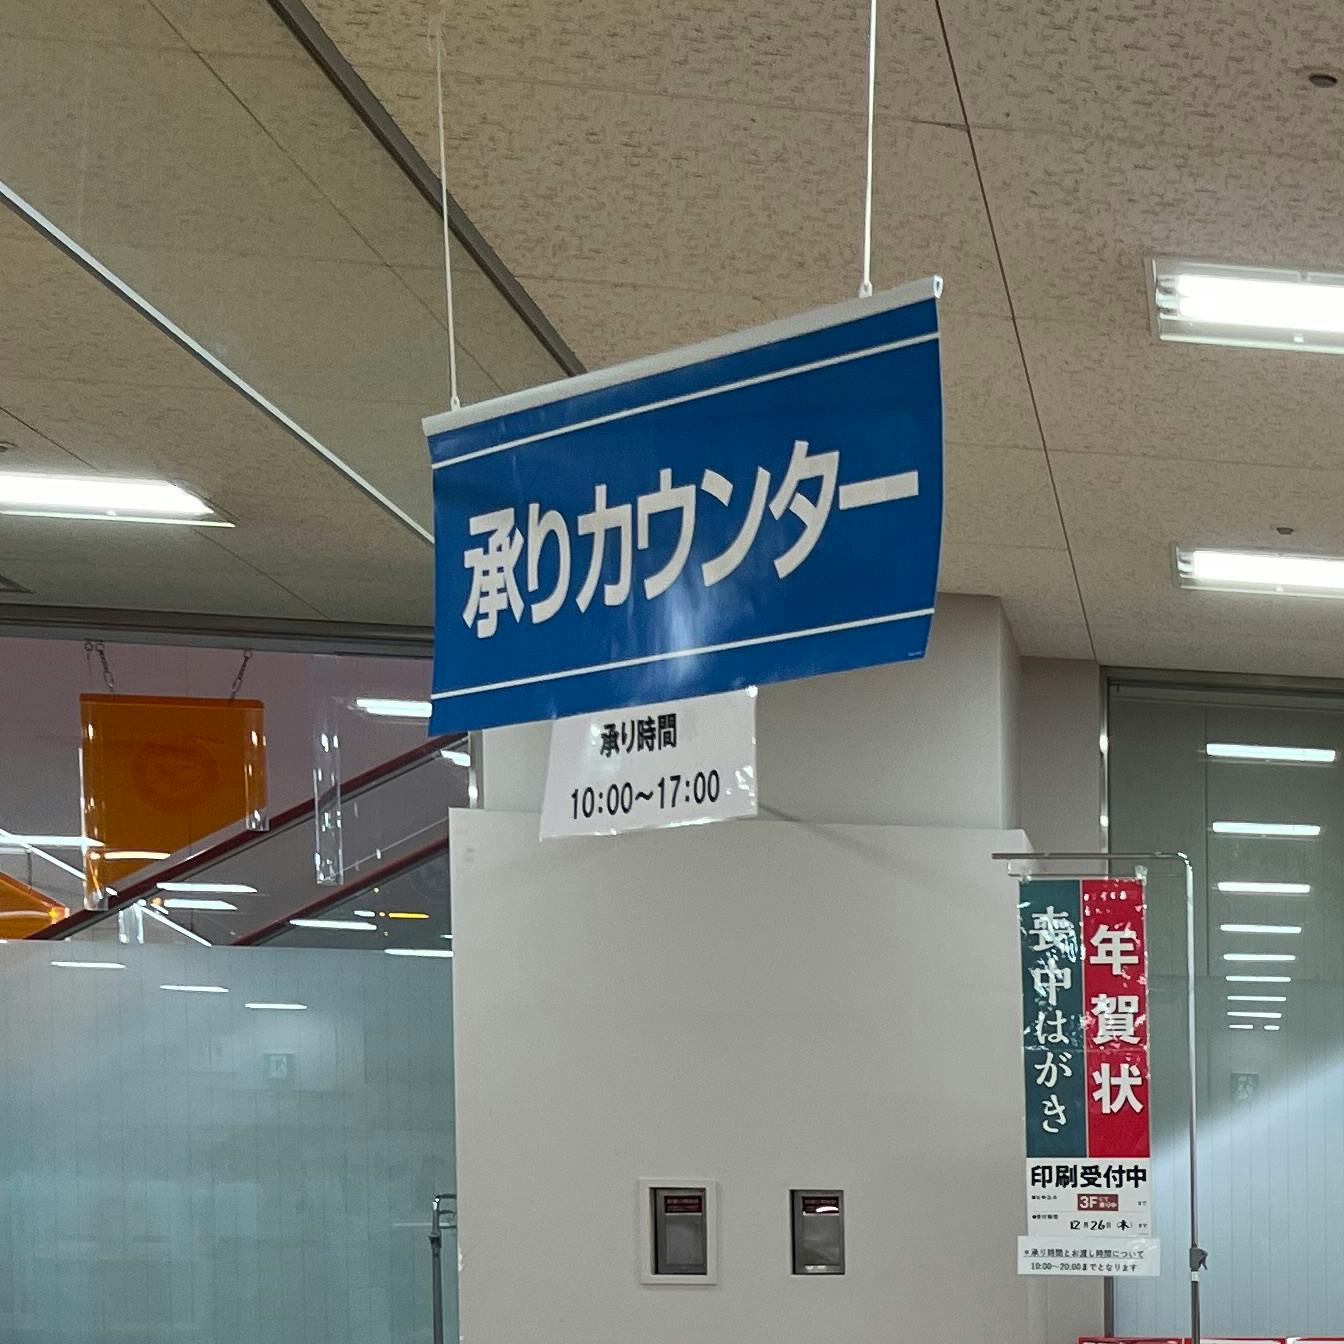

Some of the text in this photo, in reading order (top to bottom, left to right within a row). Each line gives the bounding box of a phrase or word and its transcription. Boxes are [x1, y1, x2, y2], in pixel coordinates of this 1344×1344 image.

[463, 440, 919, 638] 承りカウンター
[599, 712, 678, 757] 承り時間
[1031, 906, 1073, 1134] 喪中はがき
[1089, 923, 1145, 1115] 年賀状
[1031, 1164, 1147, 1189] 印刷受付中
[1079, 1195, 1098, 1209] 3F
